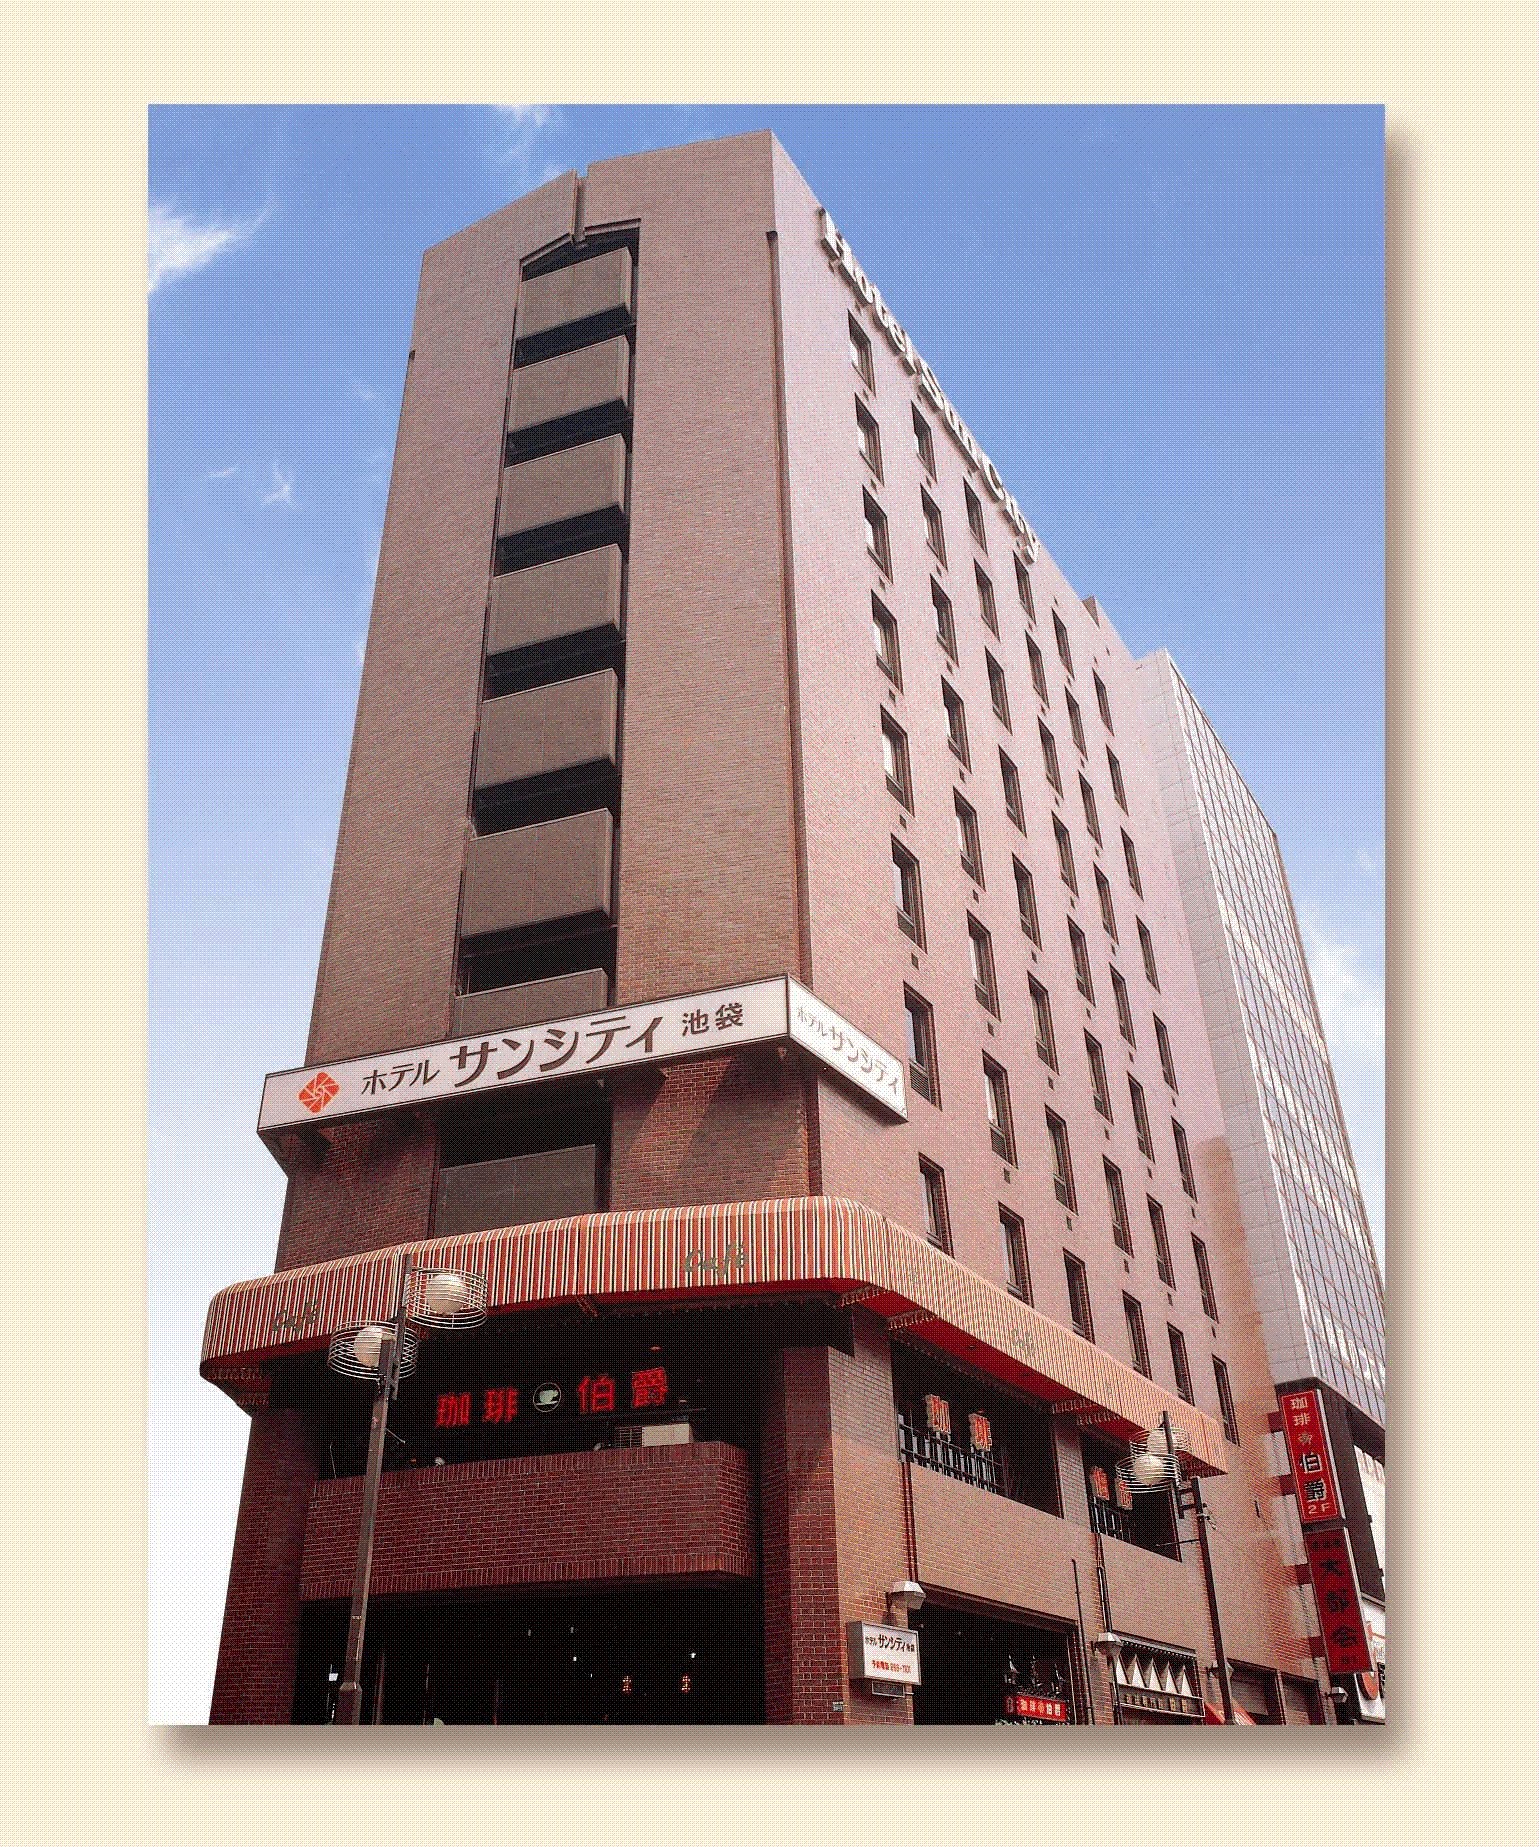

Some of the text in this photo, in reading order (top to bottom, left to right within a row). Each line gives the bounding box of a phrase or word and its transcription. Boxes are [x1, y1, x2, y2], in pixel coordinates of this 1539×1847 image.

[816, 205, 917, 377] Hotel
[978, 452, 1038, 564] City
[360, 1002, 744, 1096] ホテル サンシティ 池袋
[796, 1004, 900, 1096] ホテル サンシティ
[435, 1366, 670, 1429] 珈琲 伯爵
[1290, 1397, 1327, 1502] 珈琲 伯爵
[1307, 1502, 1332, 1515] 2F
[878, 1634, 905, 1652] サンシティ
